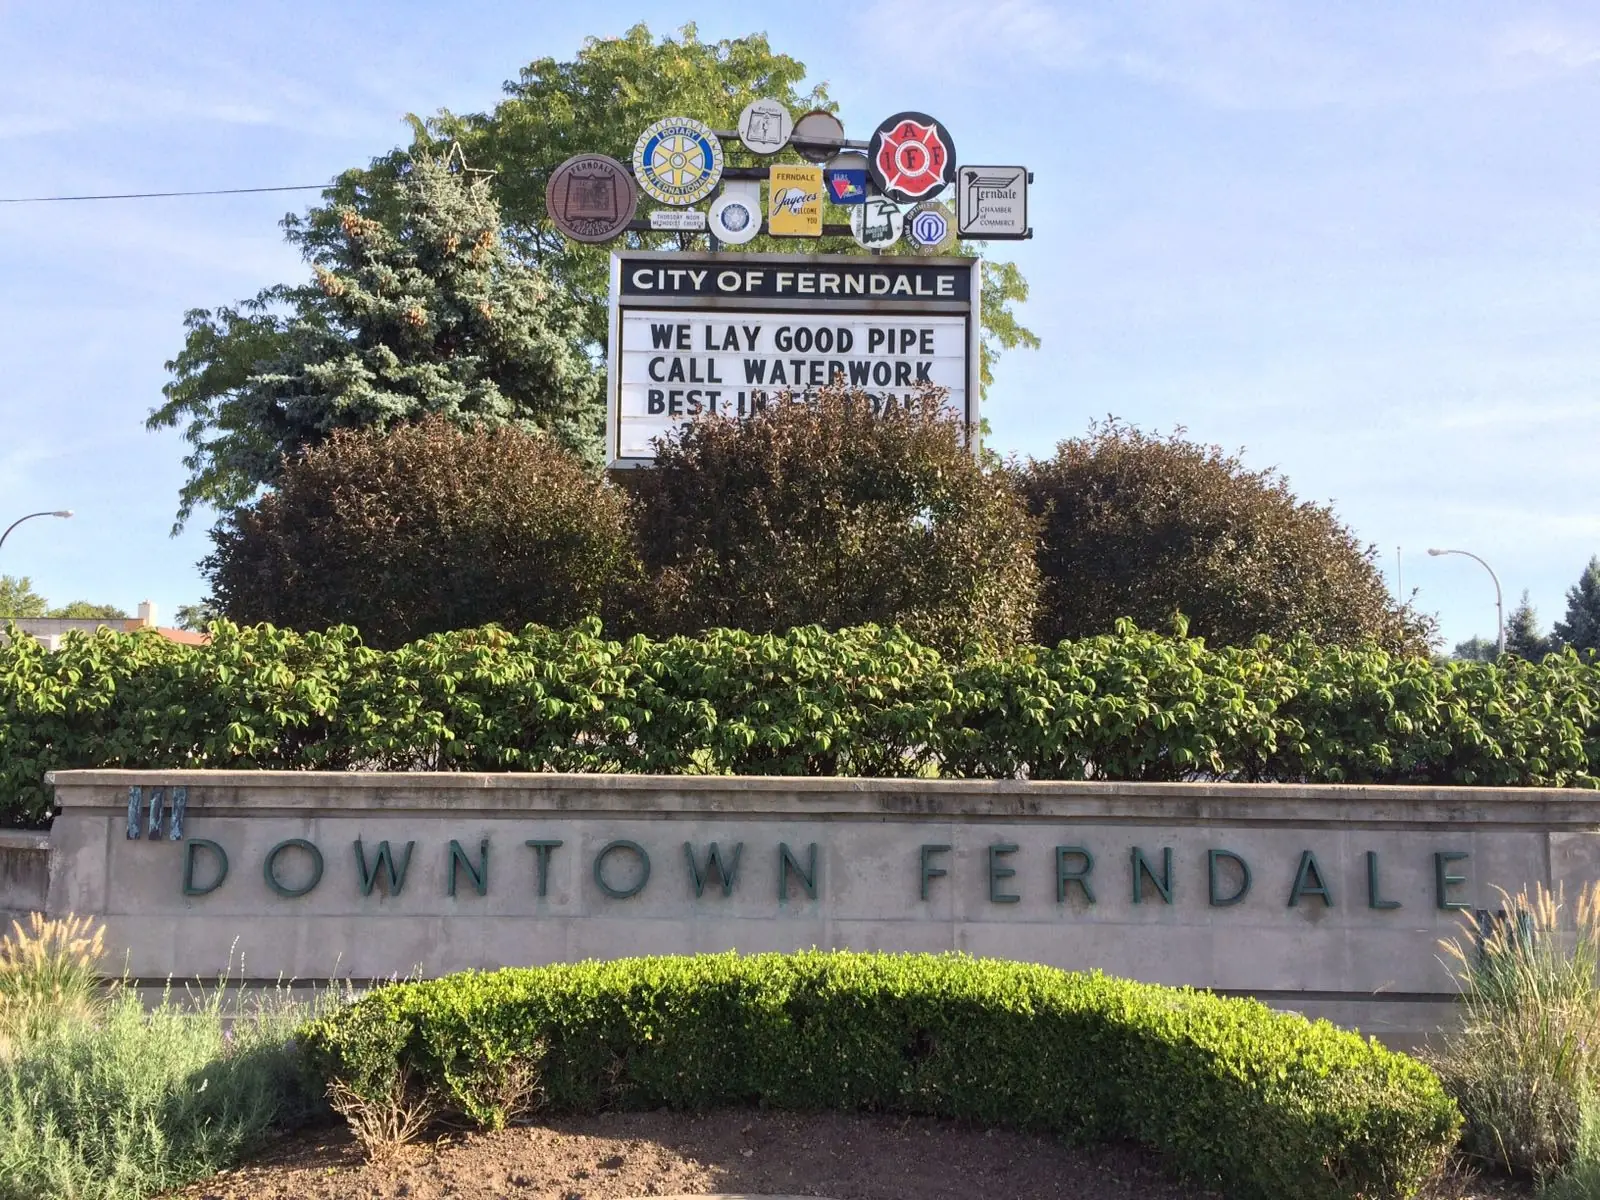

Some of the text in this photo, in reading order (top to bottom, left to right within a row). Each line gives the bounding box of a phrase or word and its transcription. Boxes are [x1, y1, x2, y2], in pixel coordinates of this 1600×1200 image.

[662, 127, 698, 138] ROTARY
[570, 161, 614, 175] FERNDALE
[645, 168, 709, 195] INTERNATIONAL
[776, 173, 816, 181] FERNDALE
[772, 187, 818, 216] Jaycees
[632, 268, 955, 297] CITY OF FERNDALE
[650, 323, 935, 355] WE LAY GOOD PIPE
[649, 356, 722, 383] CALL
[648, 389, 722, 416] BEST
[181, 837, 1472, 910] DOWNTOWN FERNDALE
